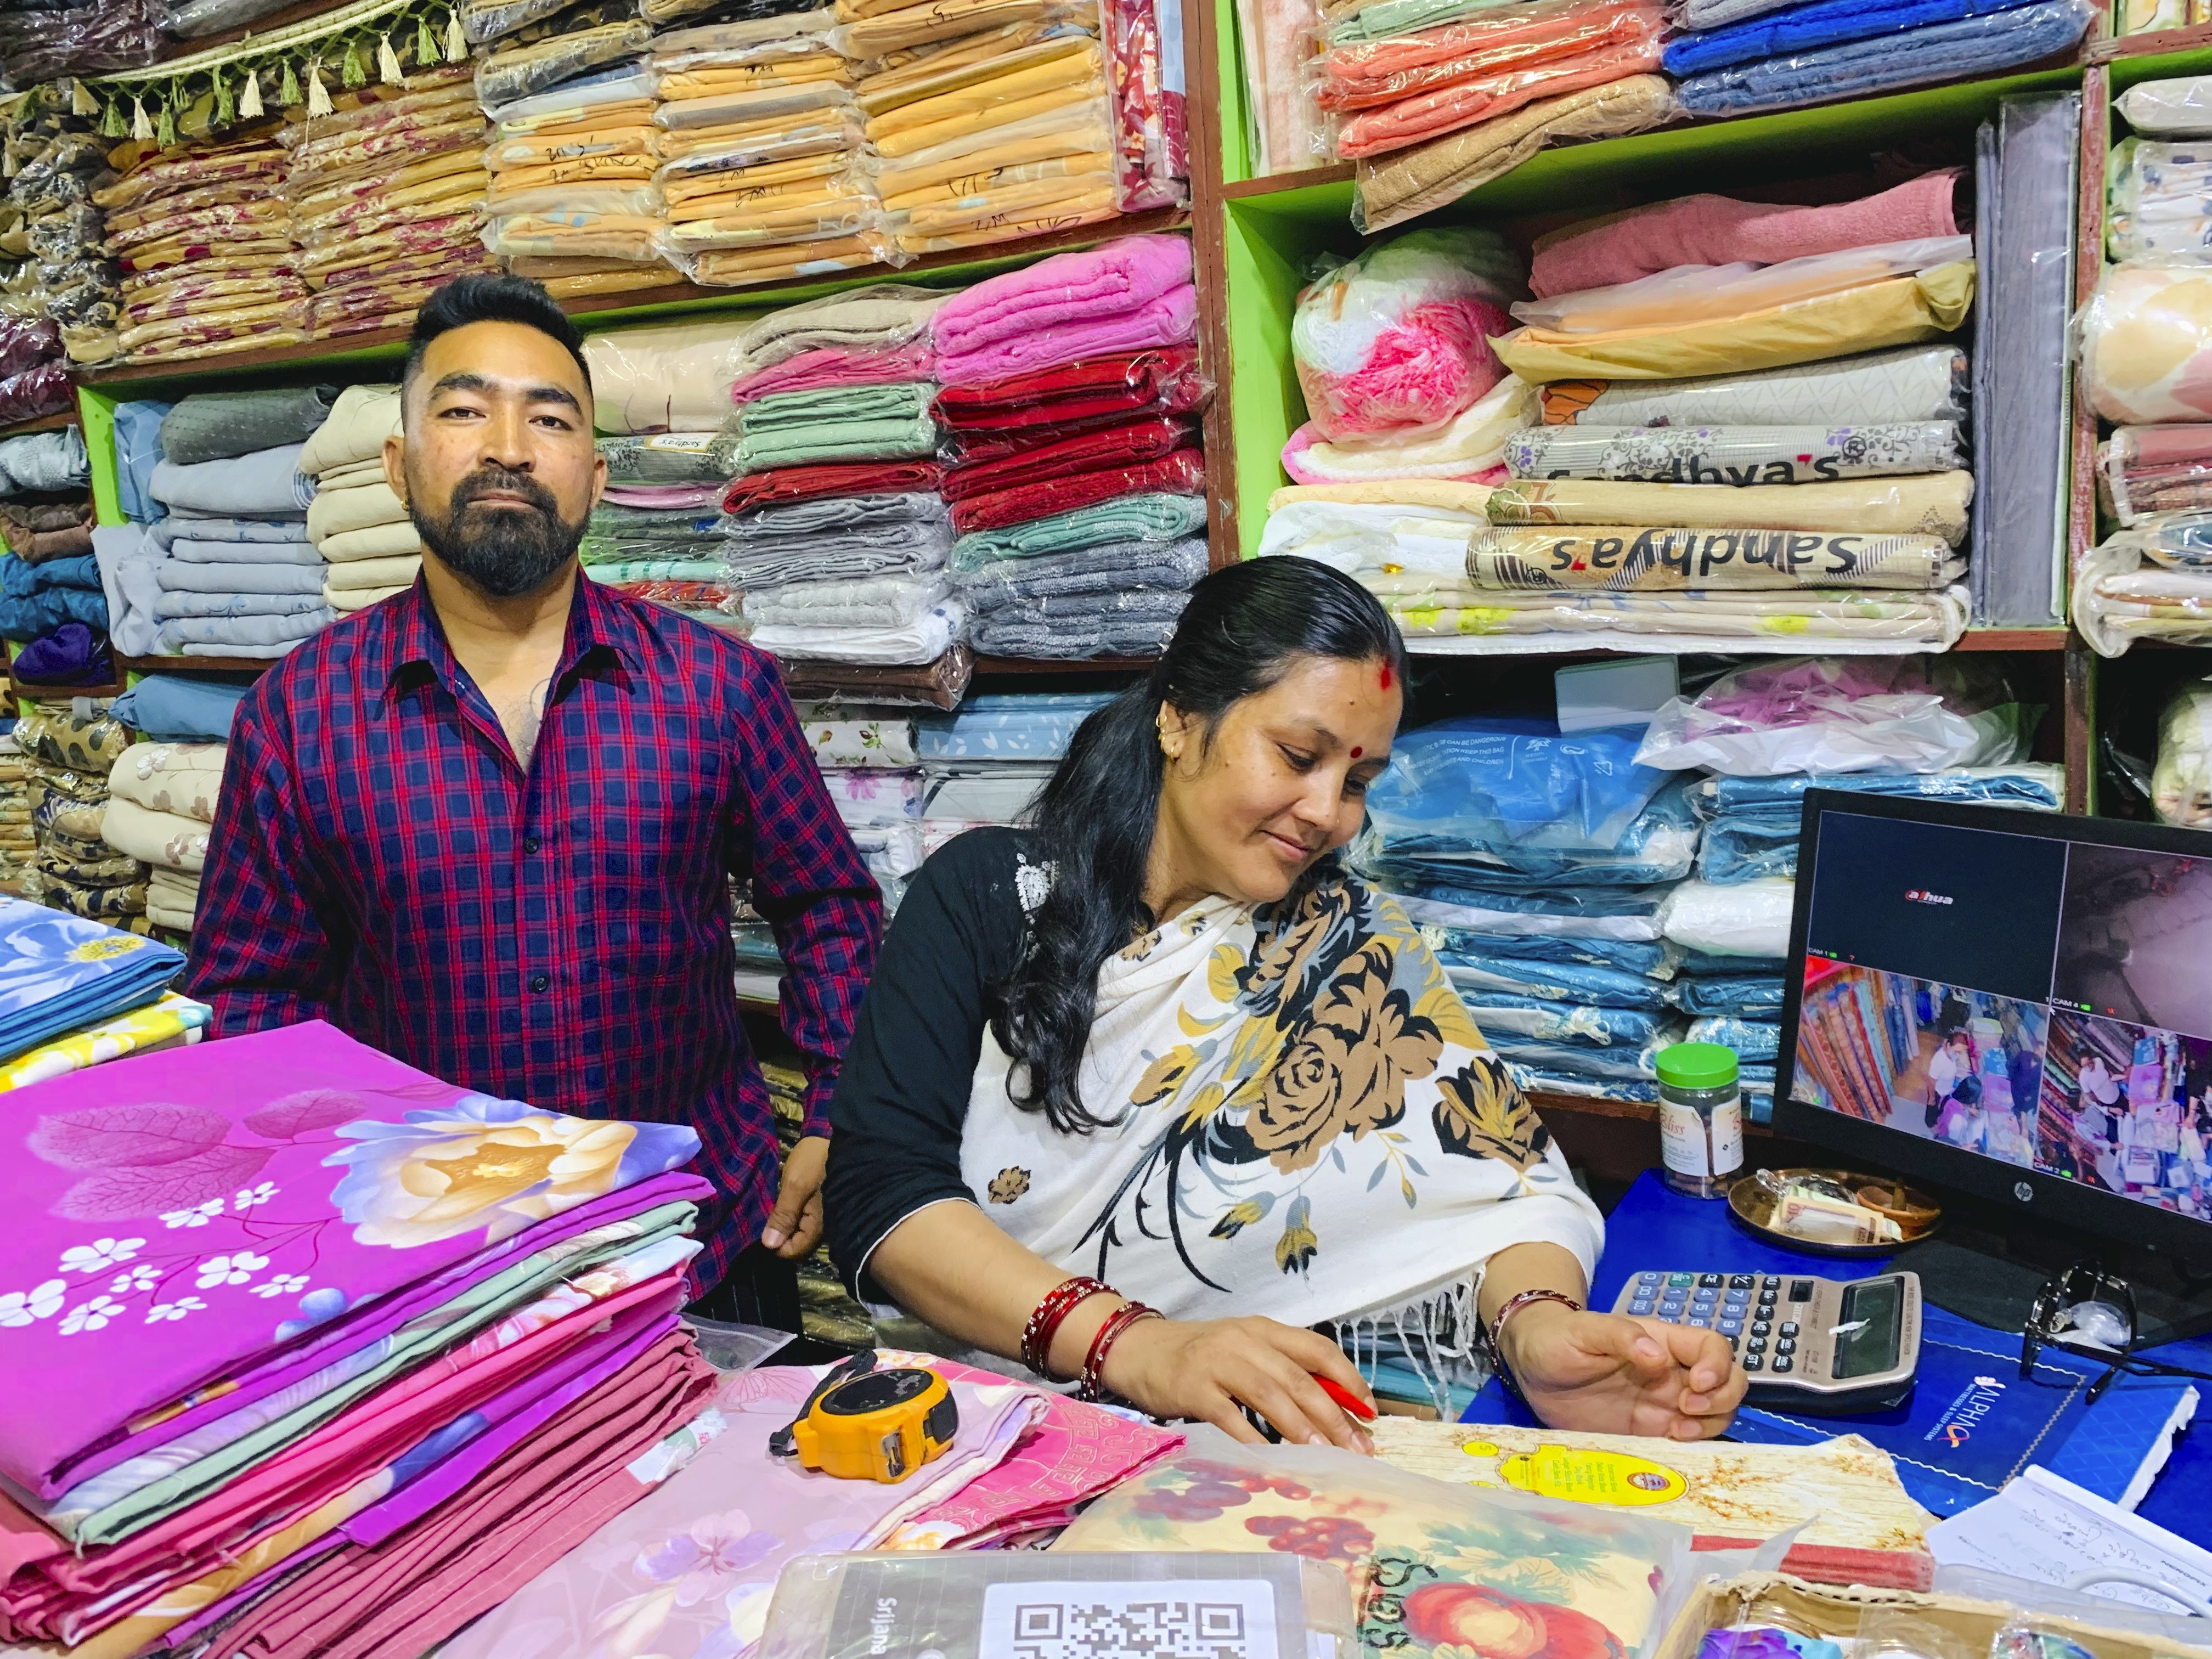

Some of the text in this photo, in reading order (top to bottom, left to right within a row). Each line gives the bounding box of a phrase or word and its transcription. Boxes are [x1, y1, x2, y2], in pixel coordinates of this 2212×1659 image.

[1551, 529, 1863, 576] Sandhya's
[1470, 737, 1507, 745] DANGEROUS
[2052, 998, 2072, 1006] CAM
[1638, 1286, 1652, 1295] 00
[1747, 1355, 1759, 1365] GT
[1924, 1424, 1944, 1441] SYSTEMS
[870, 1597, 896, 1655] Srijana
